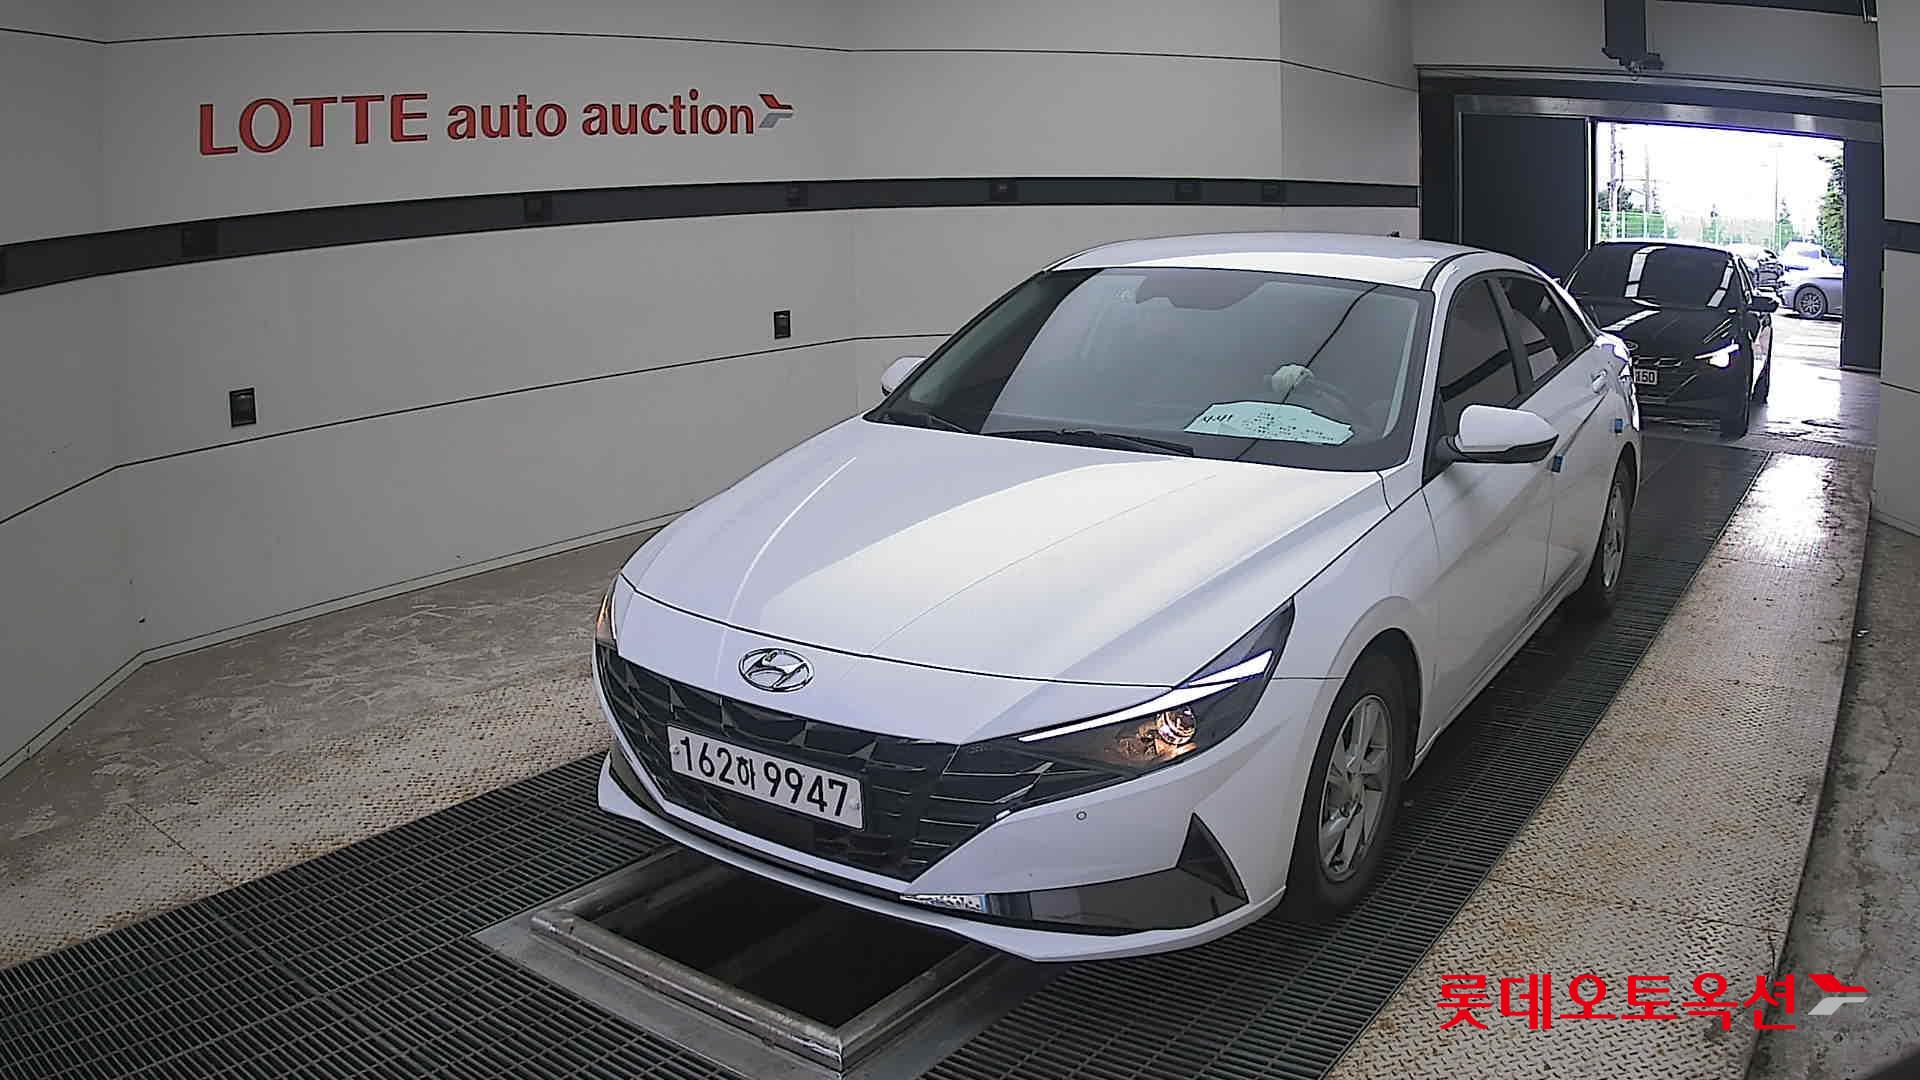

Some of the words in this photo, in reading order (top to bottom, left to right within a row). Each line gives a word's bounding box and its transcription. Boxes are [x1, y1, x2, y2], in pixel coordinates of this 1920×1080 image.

[199, 93, 428, 156] LOTTE
[447, 94, 567, 140] auto
[582, 89, 755, 136] auction
[680, 736, 756, 790] 162하
[763, 760, 849, 817] 9947
